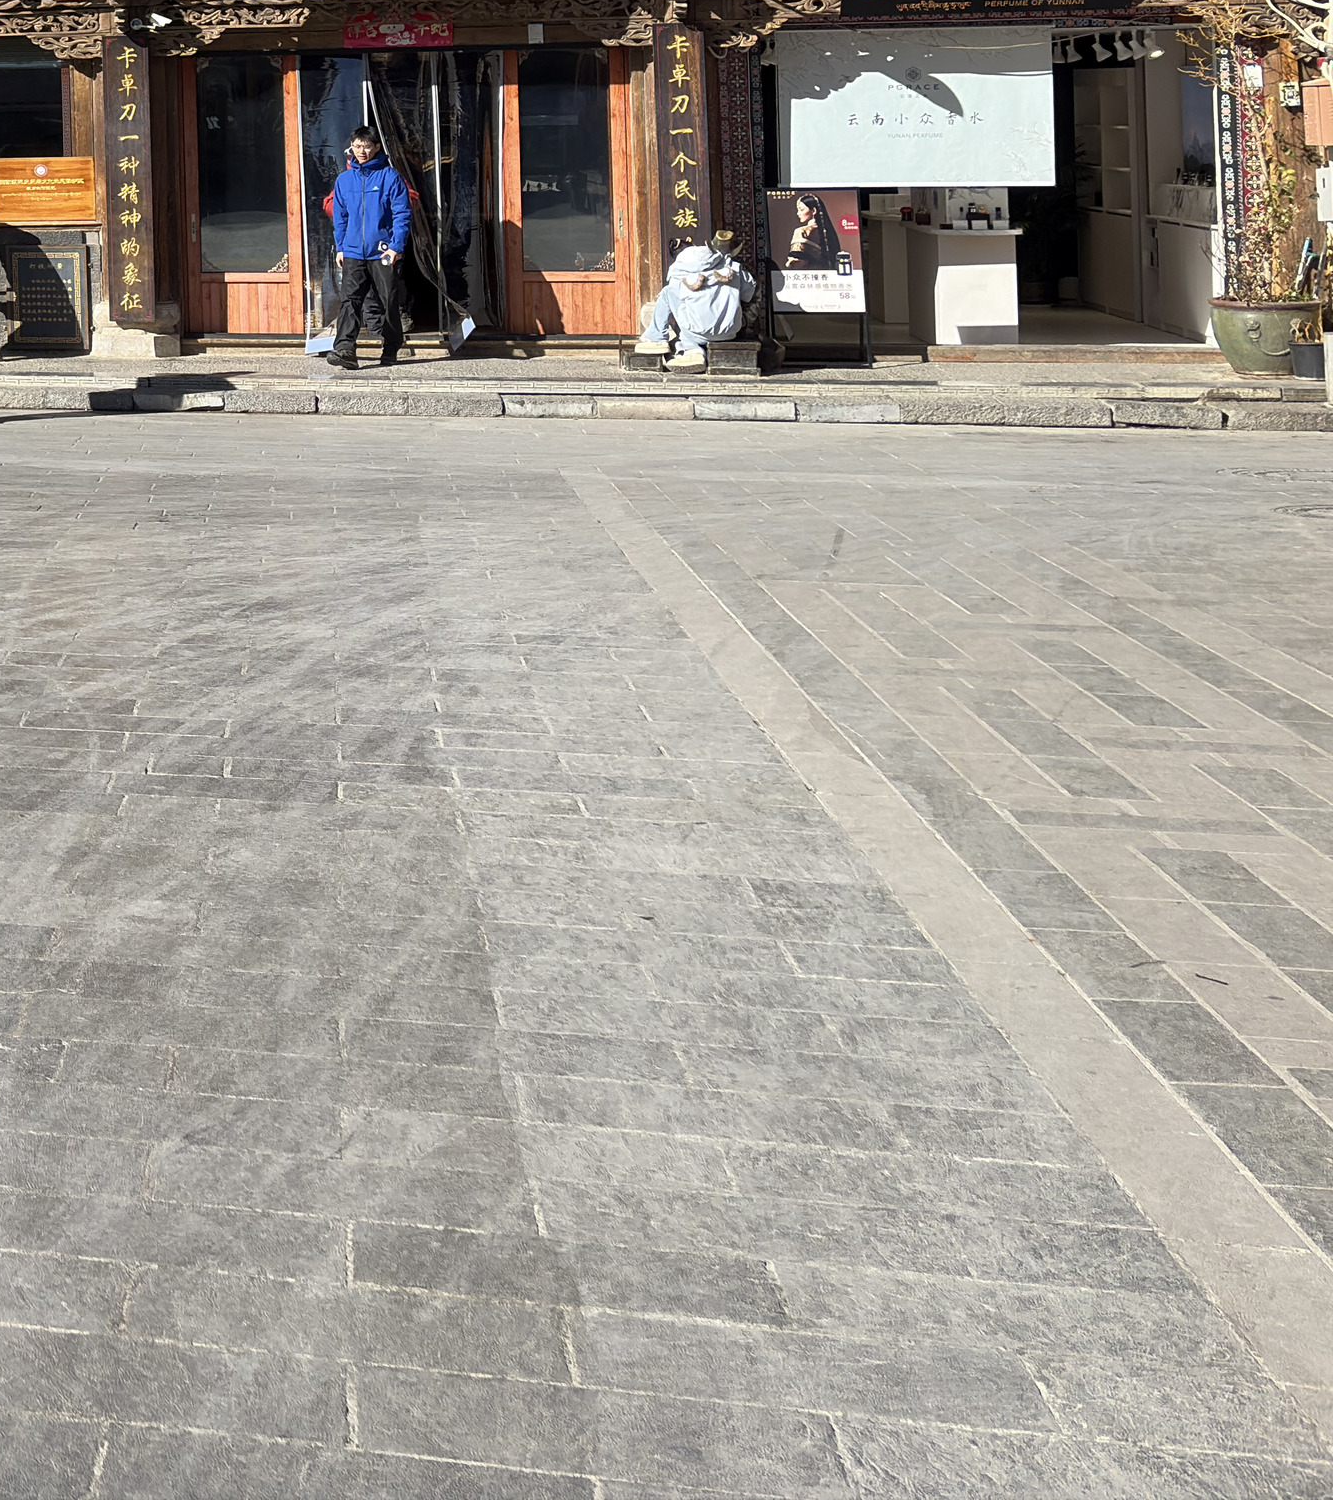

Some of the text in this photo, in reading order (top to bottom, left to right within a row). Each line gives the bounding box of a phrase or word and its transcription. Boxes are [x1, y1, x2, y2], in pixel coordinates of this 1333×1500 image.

[117, 46, 143, 311] 卡卓刀一种精神的象征
[848, 111, 983, 126] 云南小众香水
